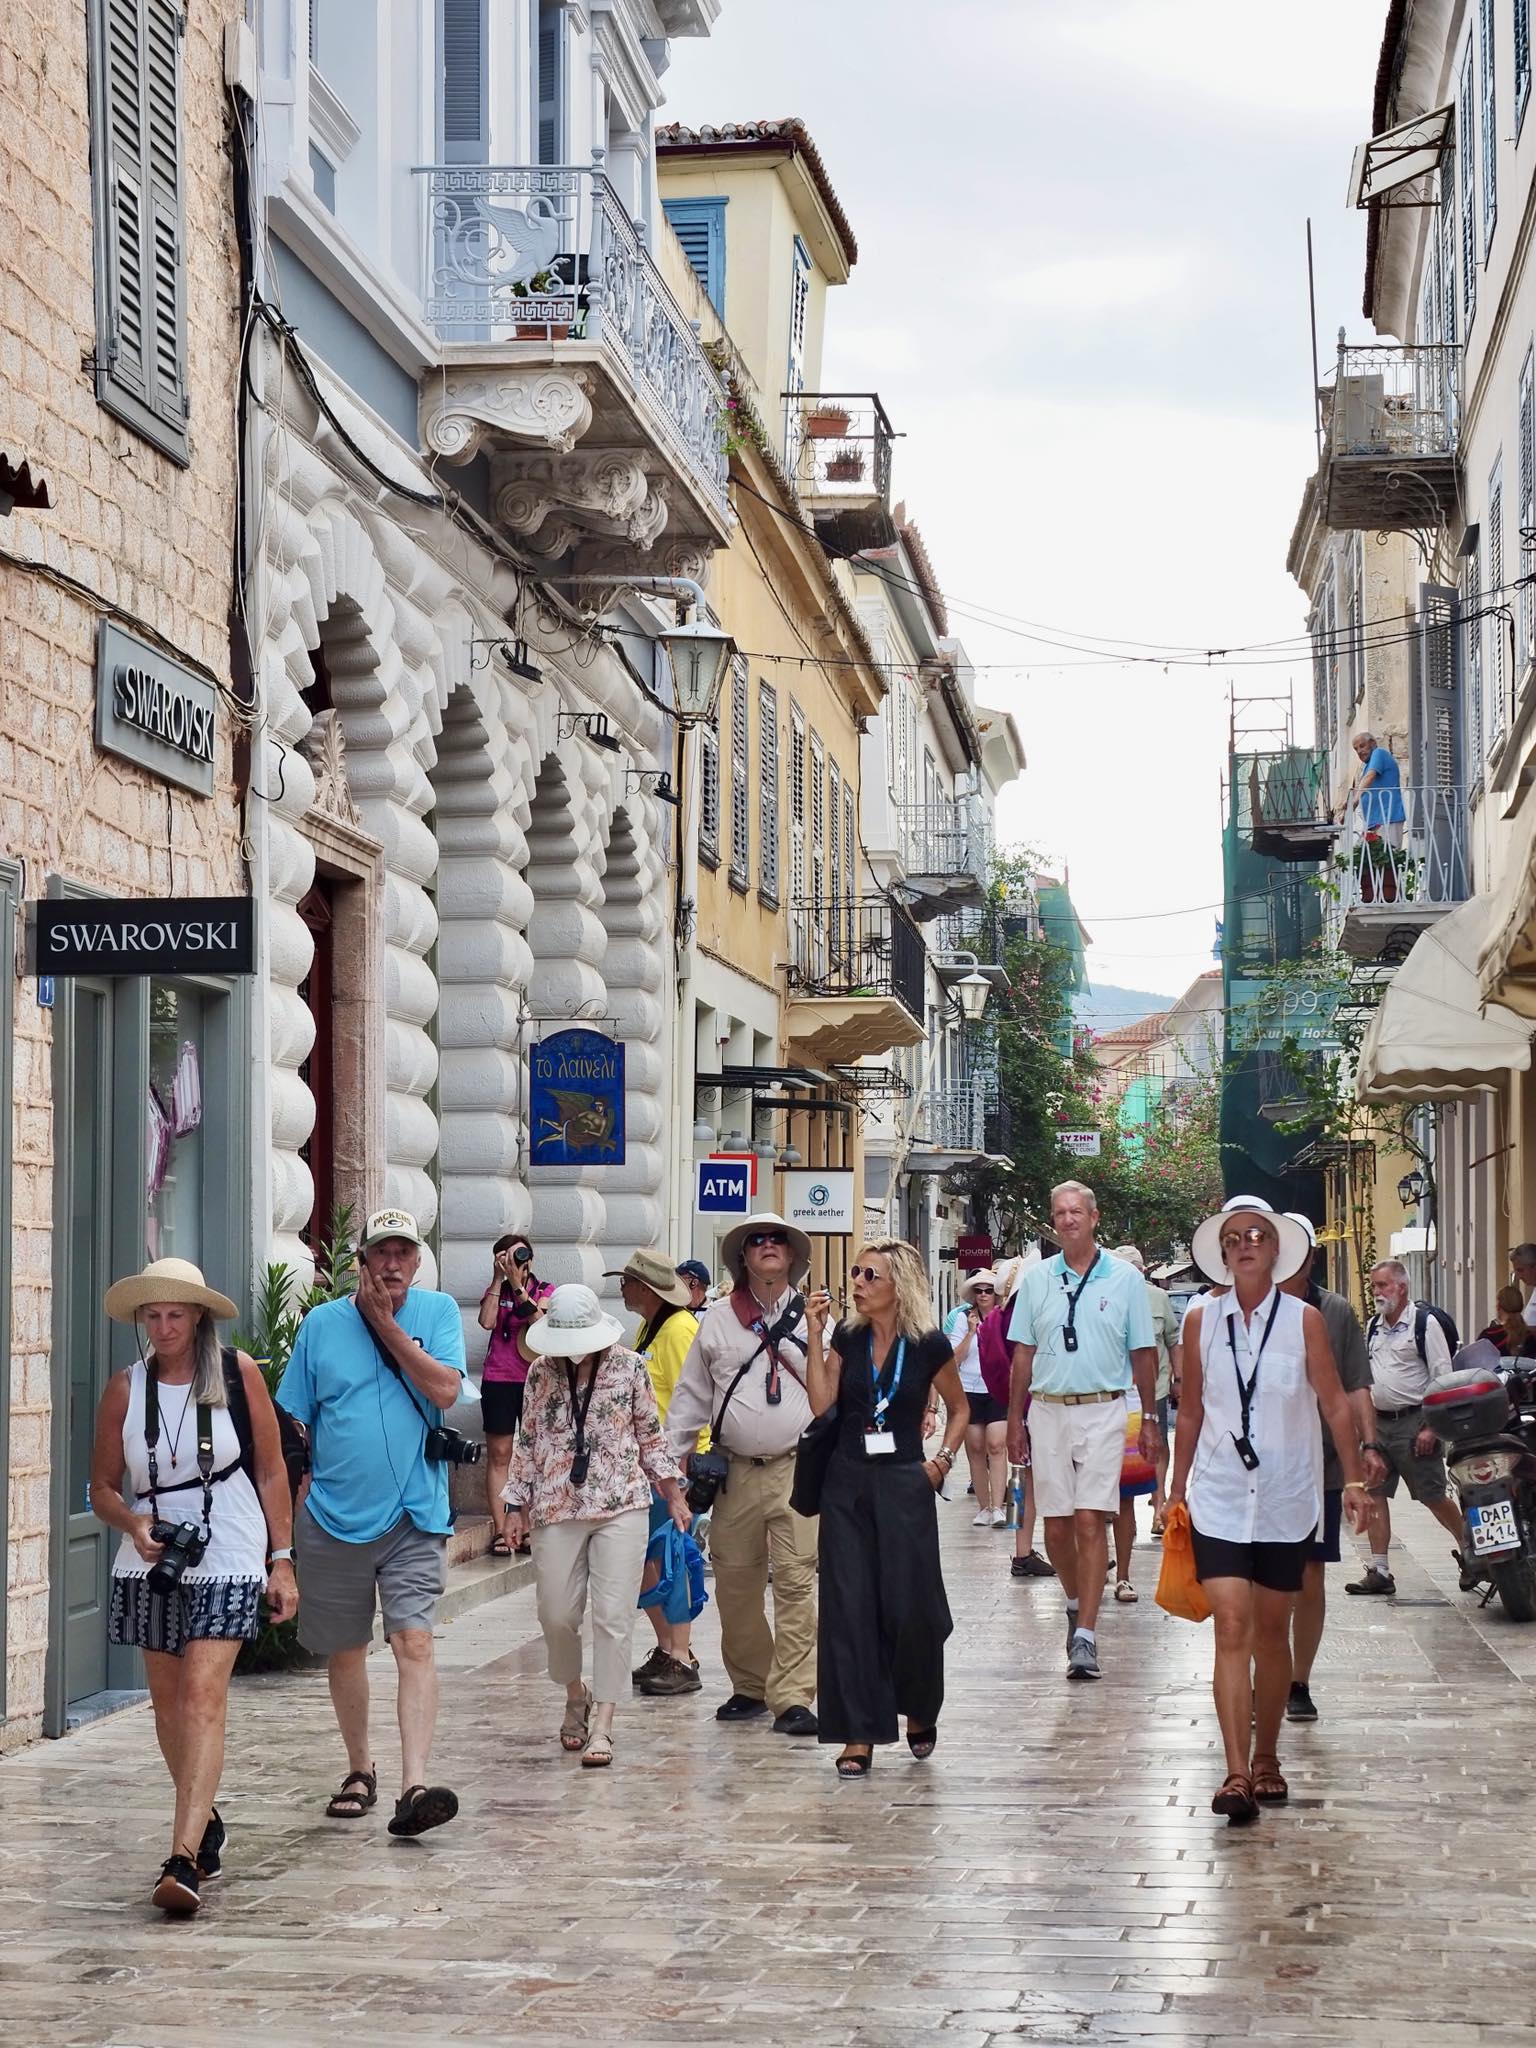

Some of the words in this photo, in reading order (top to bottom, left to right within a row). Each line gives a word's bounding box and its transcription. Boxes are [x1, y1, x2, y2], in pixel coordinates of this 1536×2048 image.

[50, 921, 238, 952] SWAROVSKI
[703, 1178, 744, 1197] ATM
[793, 1208, 816, 1218] greek
[817, 1208, 844, 1217] aether
